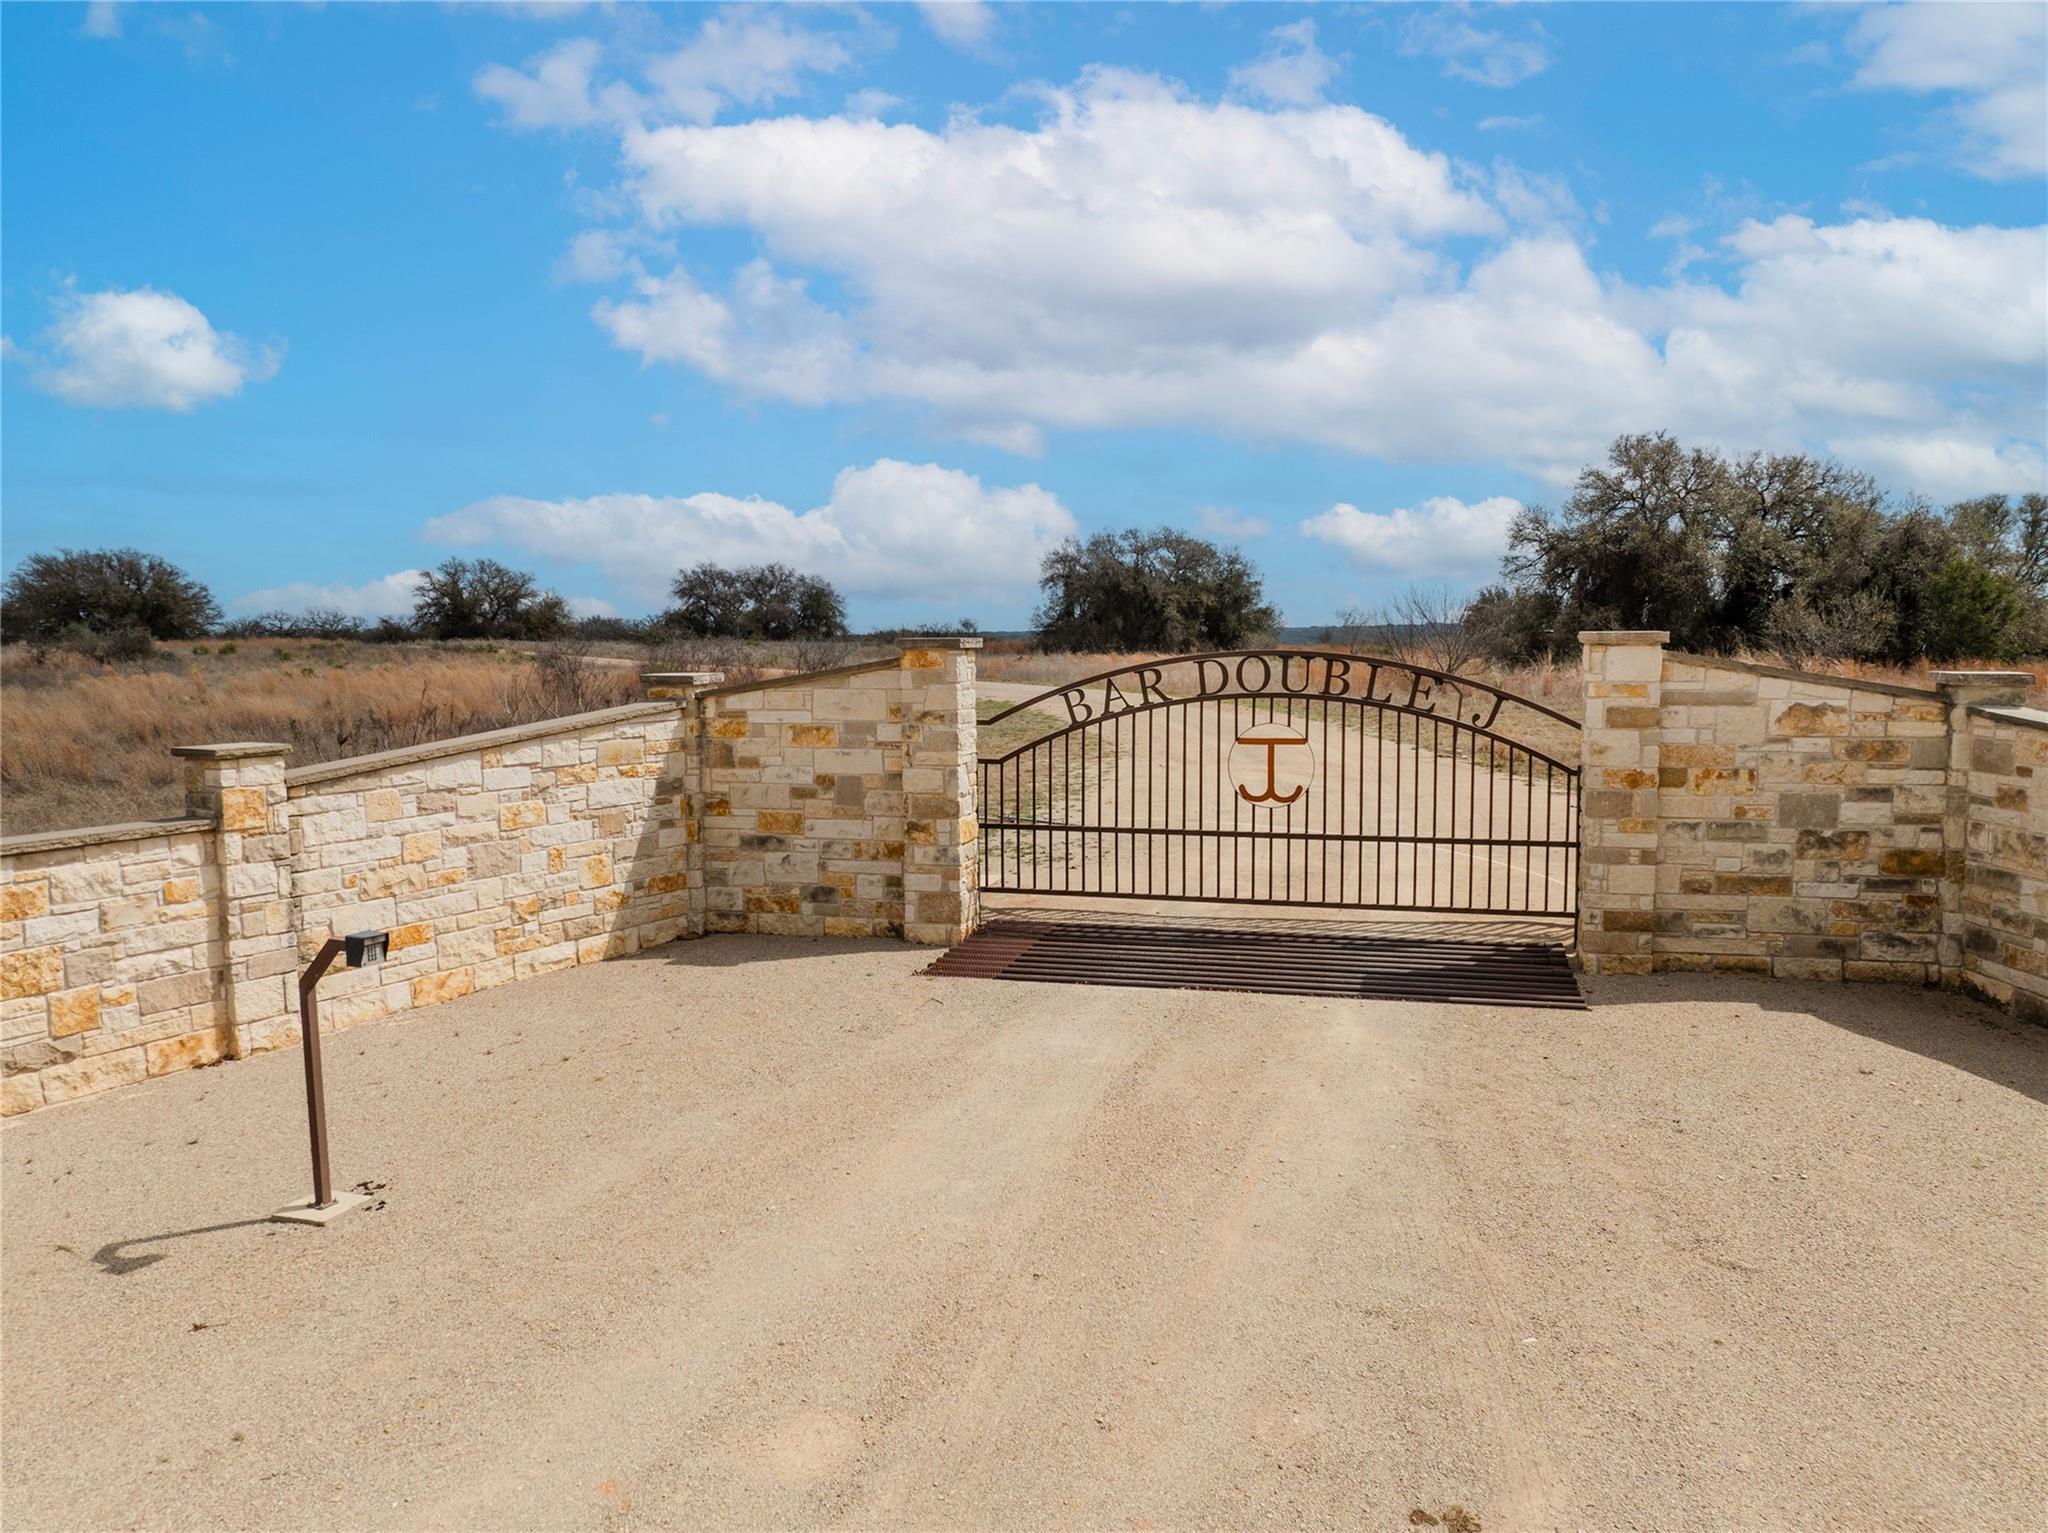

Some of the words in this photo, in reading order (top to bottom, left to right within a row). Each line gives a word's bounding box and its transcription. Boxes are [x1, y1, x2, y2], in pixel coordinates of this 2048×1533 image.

[1060, 668, 1172, 727] BAR
[1194, 655, 1436, 713] DOUBLE
[1471, 693, 1508, 730] J
